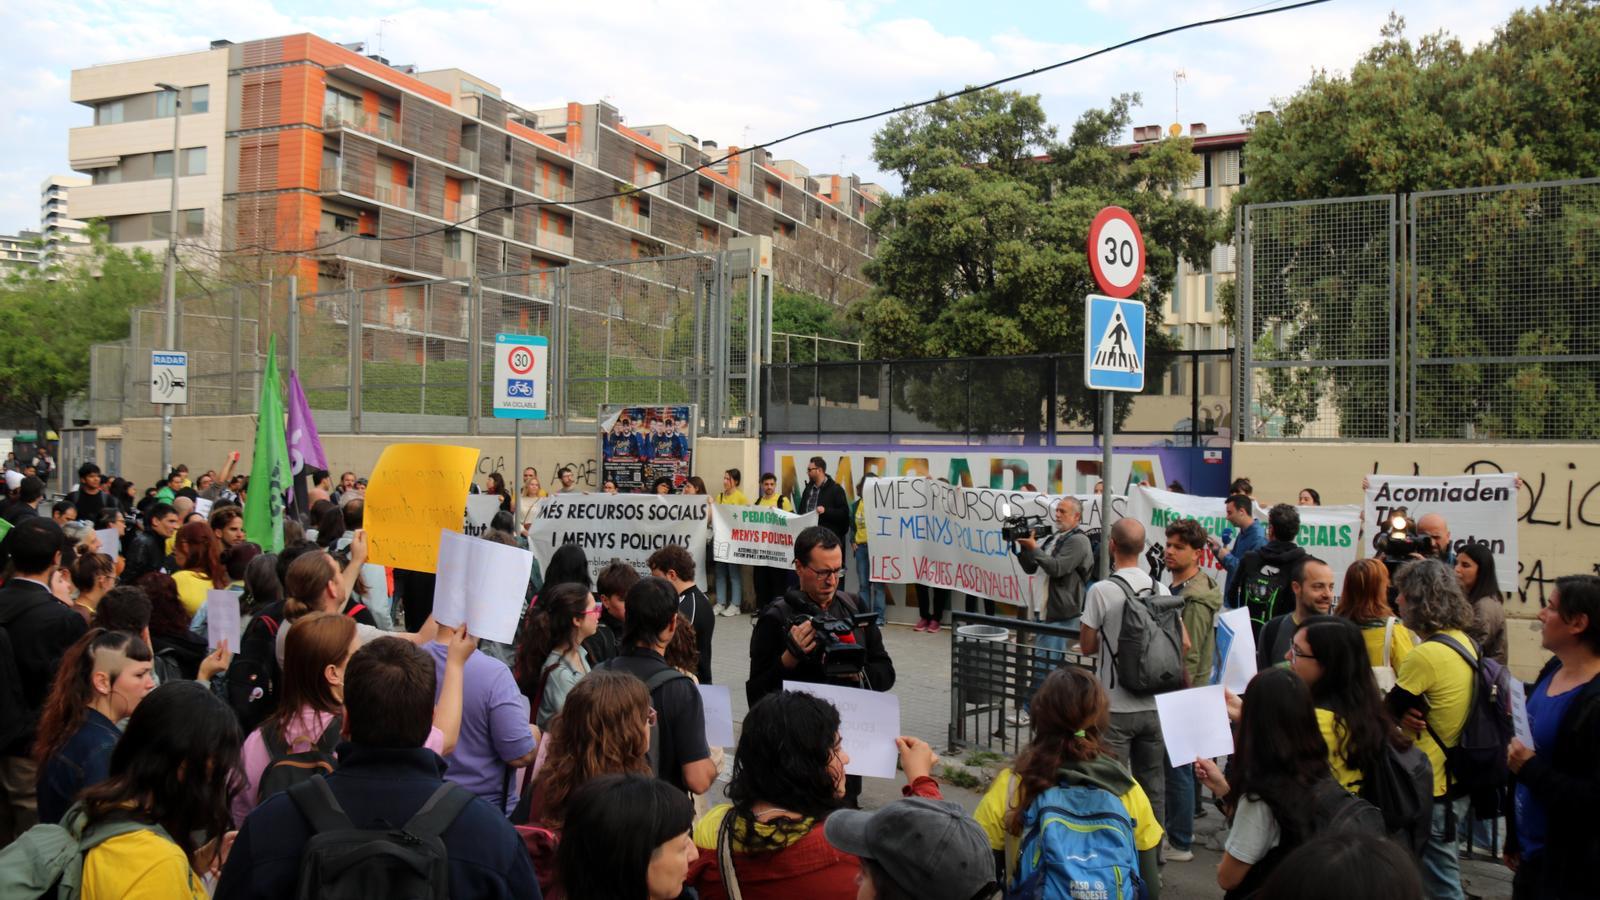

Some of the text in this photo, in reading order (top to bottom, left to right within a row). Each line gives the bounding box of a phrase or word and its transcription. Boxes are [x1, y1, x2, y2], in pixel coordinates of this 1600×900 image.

[1104, 236, 1134, 268] 30
[154, 356, 185, 365] RADAR
[514, 353, 529, 368] 30
[1374, 479, 1510, 502] Acomiaden
[873, 479, 927, 509] MÉS
[930, 482, 1025, 523] RECURSOS
[567, 504, 644, 520] RECURSOS
[648, 504, 707, 521] SOCIALS
[731, 529, 793, 546] MENYS POLICIA
[877, 516, 891, 536] I
[900, 515, 953, 545] MENYS
[552, 532, 691, 550] I MENYS POLICIALS
[872, 556, 901, 580] LES
[913, 556, 952, 587] VAGUES
[955, 563, 1019, 601] ASSENYALEN
